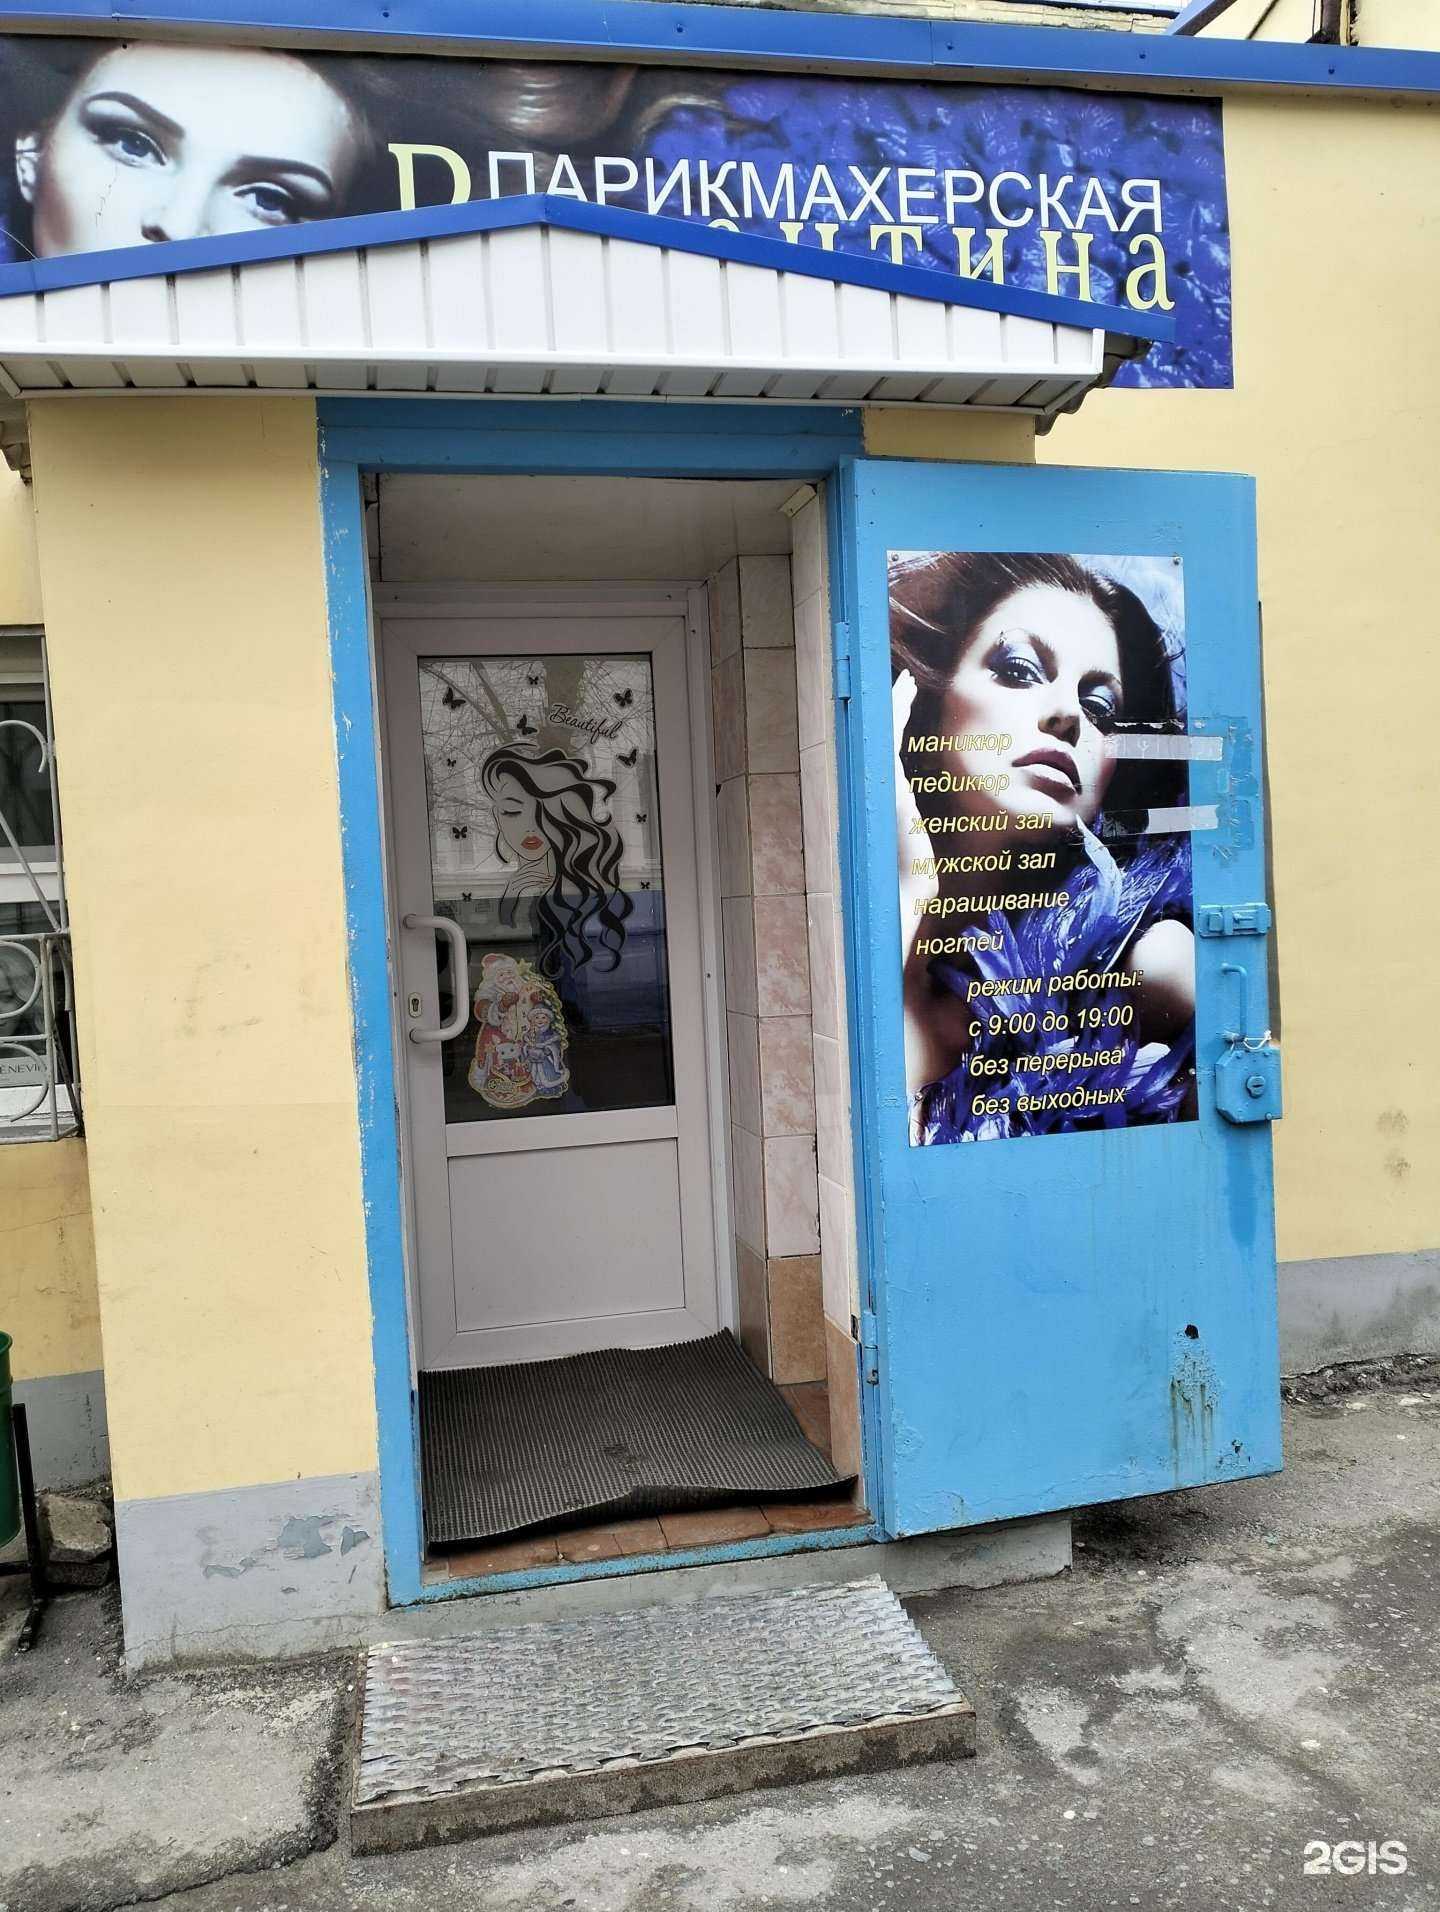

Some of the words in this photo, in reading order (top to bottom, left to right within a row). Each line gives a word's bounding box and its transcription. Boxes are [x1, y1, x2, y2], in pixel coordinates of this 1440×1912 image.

[487, 150, 1163, 233] ПАРИКМАХЕРСКАЯ
[549, 704, 623, 744] Beautiful
[907, 733, 1012, 755] маникюр
[909, 770, 1010, 796] педикюр
[909, 809, 1009, 835] женский
[1014, 812, 1054, 830] зал
[911, 850, 1012, 879] мужской
[1017, 852, 1057, 870] зал
[914, 890, 1070, 919] наращивание
[916, 930, 1004, 955] ногтей
[967, 977, 1042, 1002] режим
[1047, 968, 1145, 996] работы:
[968, 1021, 983, 1037] с
[988, 1012, 1036, 1035] 9:00
[1042, 1011, 1069, 1032] до
[1077, 1005, 1134, 1029] 19:00
[969, 1055, 1009, 1077] без
[1015, 1049, 1123, 1076] перерыва
[971, 1094, 1010, 1116] без
[1016, 1086, 1126, 1112] выходных
